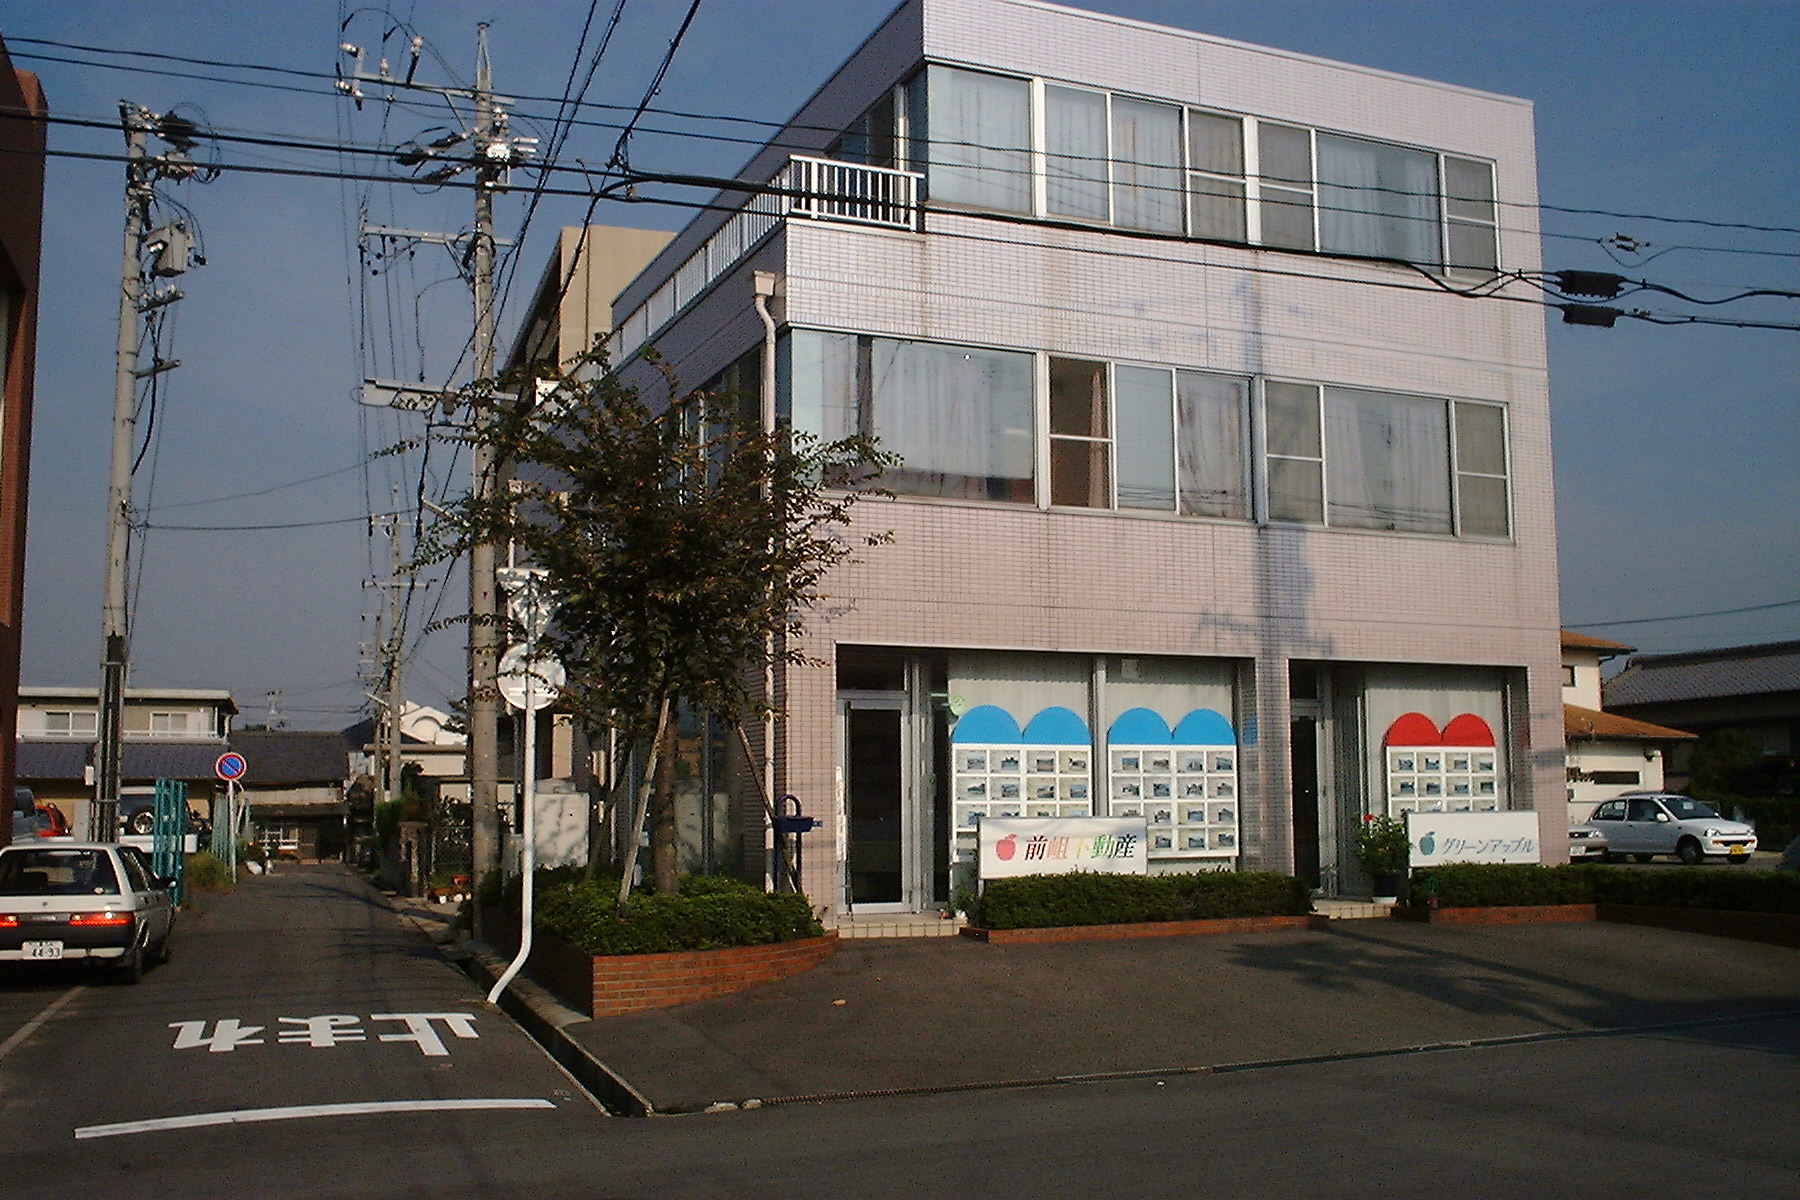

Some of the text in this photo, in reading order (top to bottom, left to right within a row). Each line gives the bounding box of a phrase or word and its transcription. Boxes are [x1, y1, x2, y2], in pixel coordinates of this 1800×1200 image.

[1442, 837, 1534, 855] グリーンアップル
[168, 1012, 480, 1056] 止まれ
